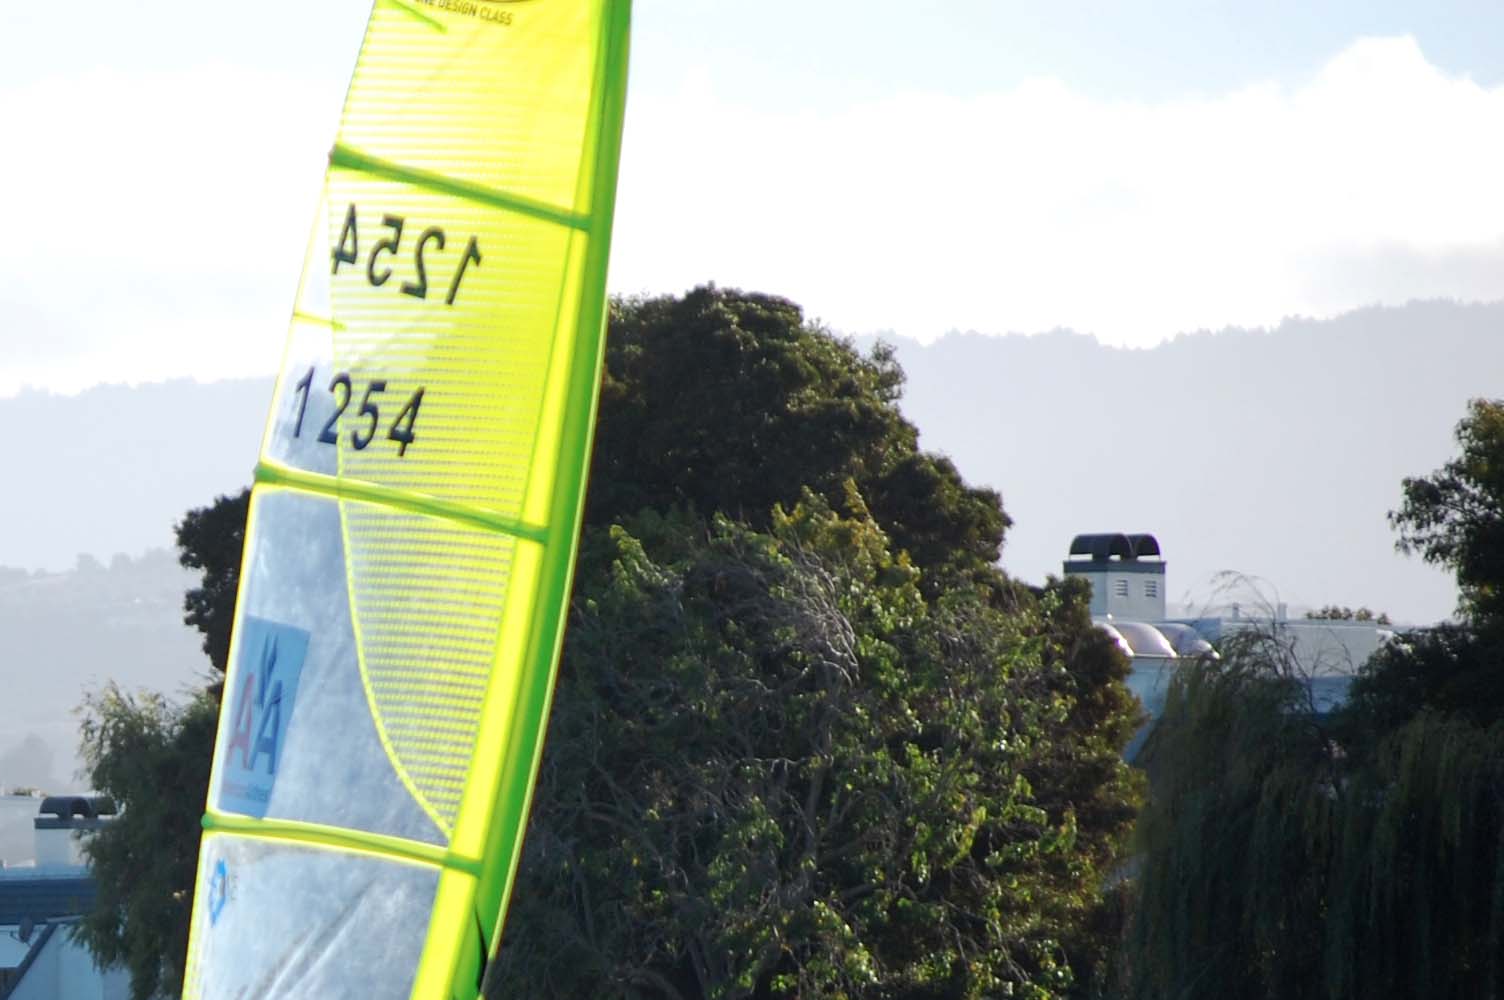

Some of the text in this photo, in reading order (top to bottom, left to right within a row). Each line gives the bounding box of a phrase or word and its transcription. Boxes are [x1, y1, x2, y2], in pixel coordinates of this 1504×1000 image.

[437, 0, 477, 17] DESIGN
[479, 6, 513, 26] CLASS
[293, 365, 426, 458] 1254
